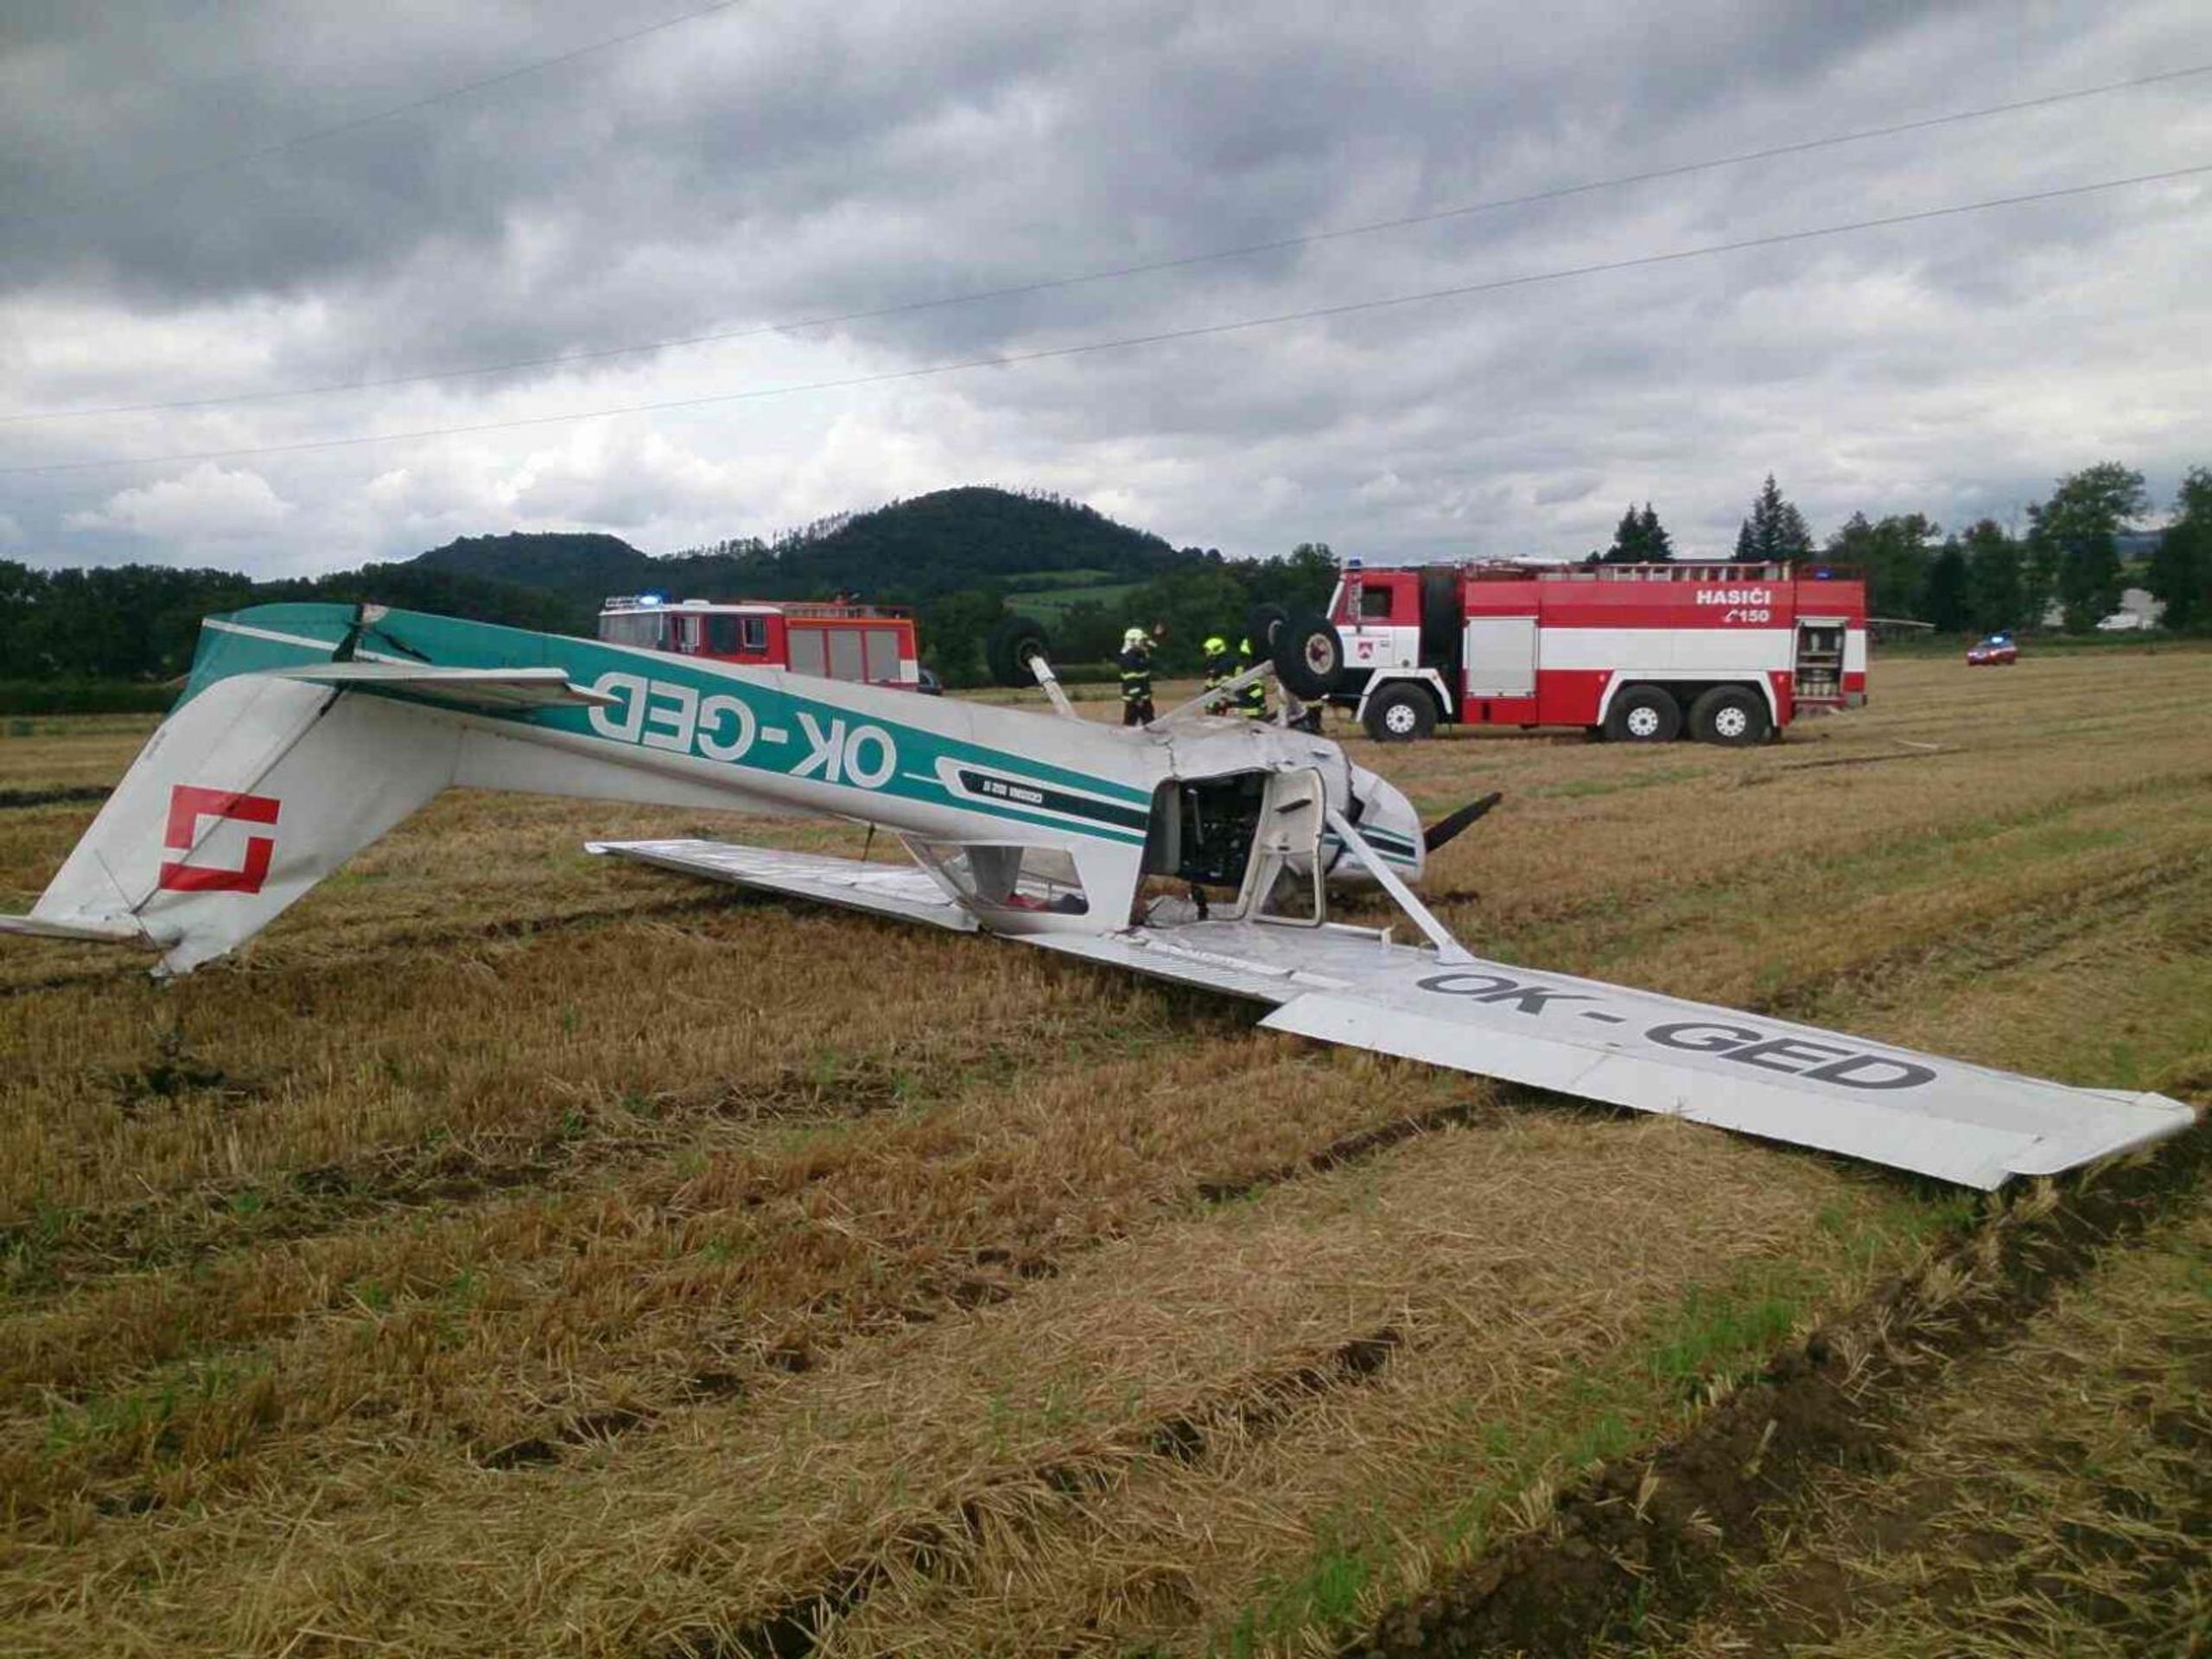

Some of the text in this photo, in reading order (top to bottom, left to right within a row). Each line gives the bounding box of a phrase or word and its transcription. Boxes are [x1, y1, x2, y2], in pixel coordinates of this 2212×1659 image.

[1696, 588, 1771, 605] HASIČI
[1739, 609, 1770, 622] 150
[588, 671, 898, 789] OK-GED
